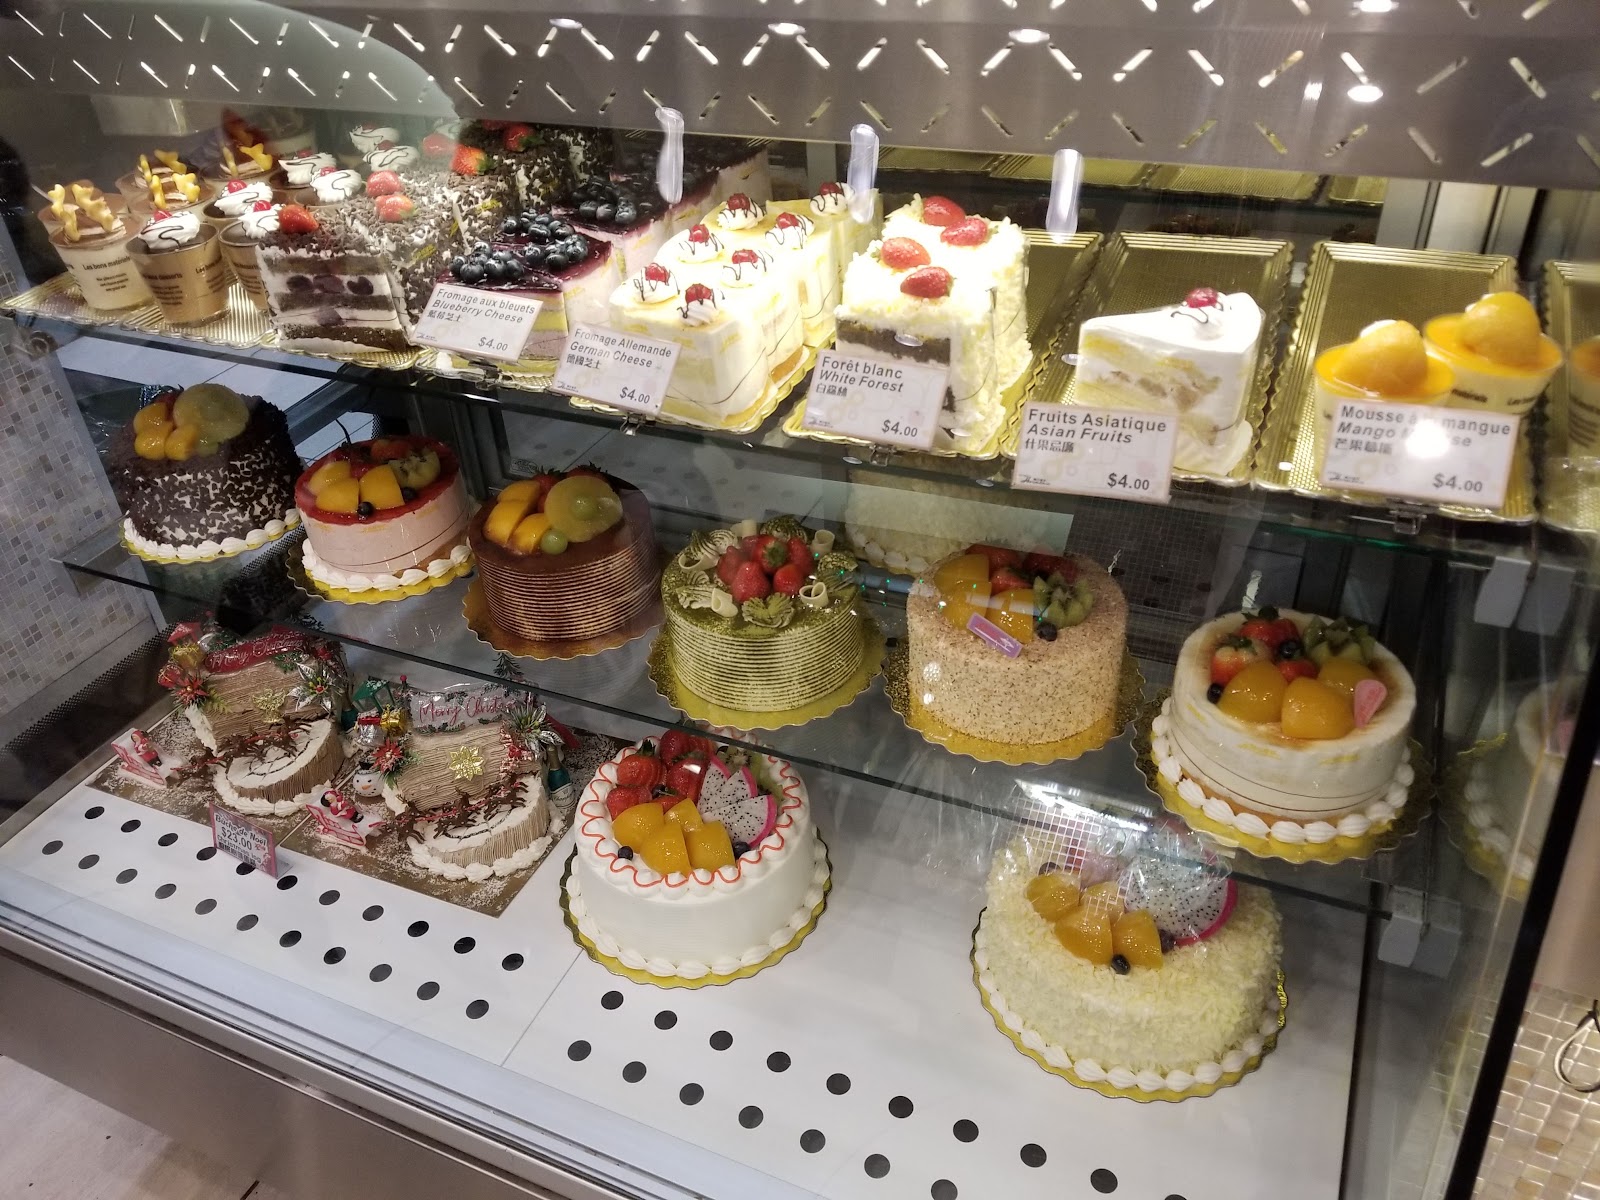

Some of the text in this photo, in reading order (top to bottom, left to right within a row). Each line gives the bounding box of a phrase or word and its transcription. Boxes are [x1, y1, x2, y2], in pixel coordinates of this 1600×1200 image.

[432, 299, 524, 324] Blueberry Cheese
[436, 288, 536, 315] Fromage aux bleuets
[477, 336, 509, 352] $4.00
[570, 341, 653, 368] German Cheese
[574, 328, 672, 358] Fromage Allemande
[822, 356, 903, 379] Forêt blanc
[819, 370, 904, 393] White Forest
[619, 387, 651, 404] $4.00
[881, 419, 918, 438] $4.00
[1028, 408, 1167, 434] Fruits Asiatique
[1337, 422, 1399, 440] Mango
[1341, 405, 1404, 423] Mousse
[1442, 417, 1511, 437] mangue
[1027, 423, 1133, 444] Asian Fruits
[1107, 472, 1150, 491] $4.00
[1433, 473, 1484, 493] $4.00
[419, 701, 461, 726] Merry
[221, 826, 252, 851] $23.00
